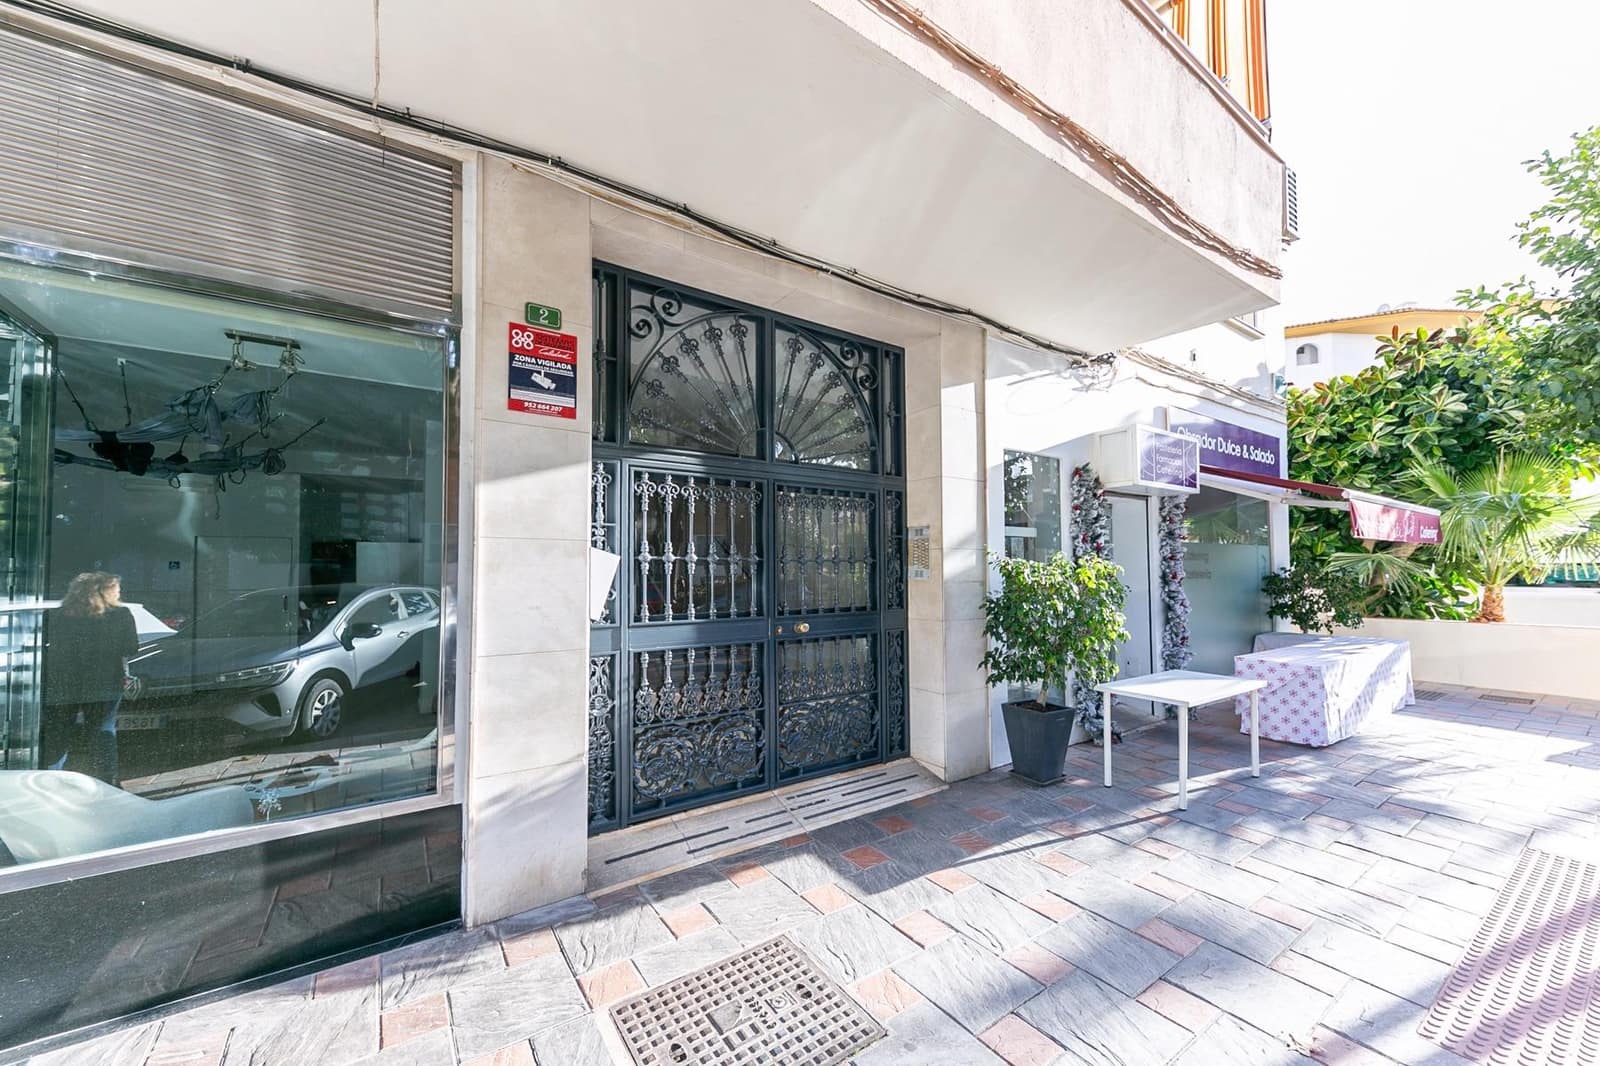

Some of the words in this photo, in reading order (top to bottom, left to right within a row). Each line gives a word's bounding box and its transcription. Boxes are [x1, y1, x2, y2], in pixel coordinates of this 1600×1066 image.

[539, 308, 549, 324] 2
[514, 354, 536, 365] ZONA
[537, 357, 573, 370] VIGILADA
[1217, 436, 1241, 457] Dulce
[1242, 444, 1249, 460] &
[1250, 444, 1275, 465] Salado
